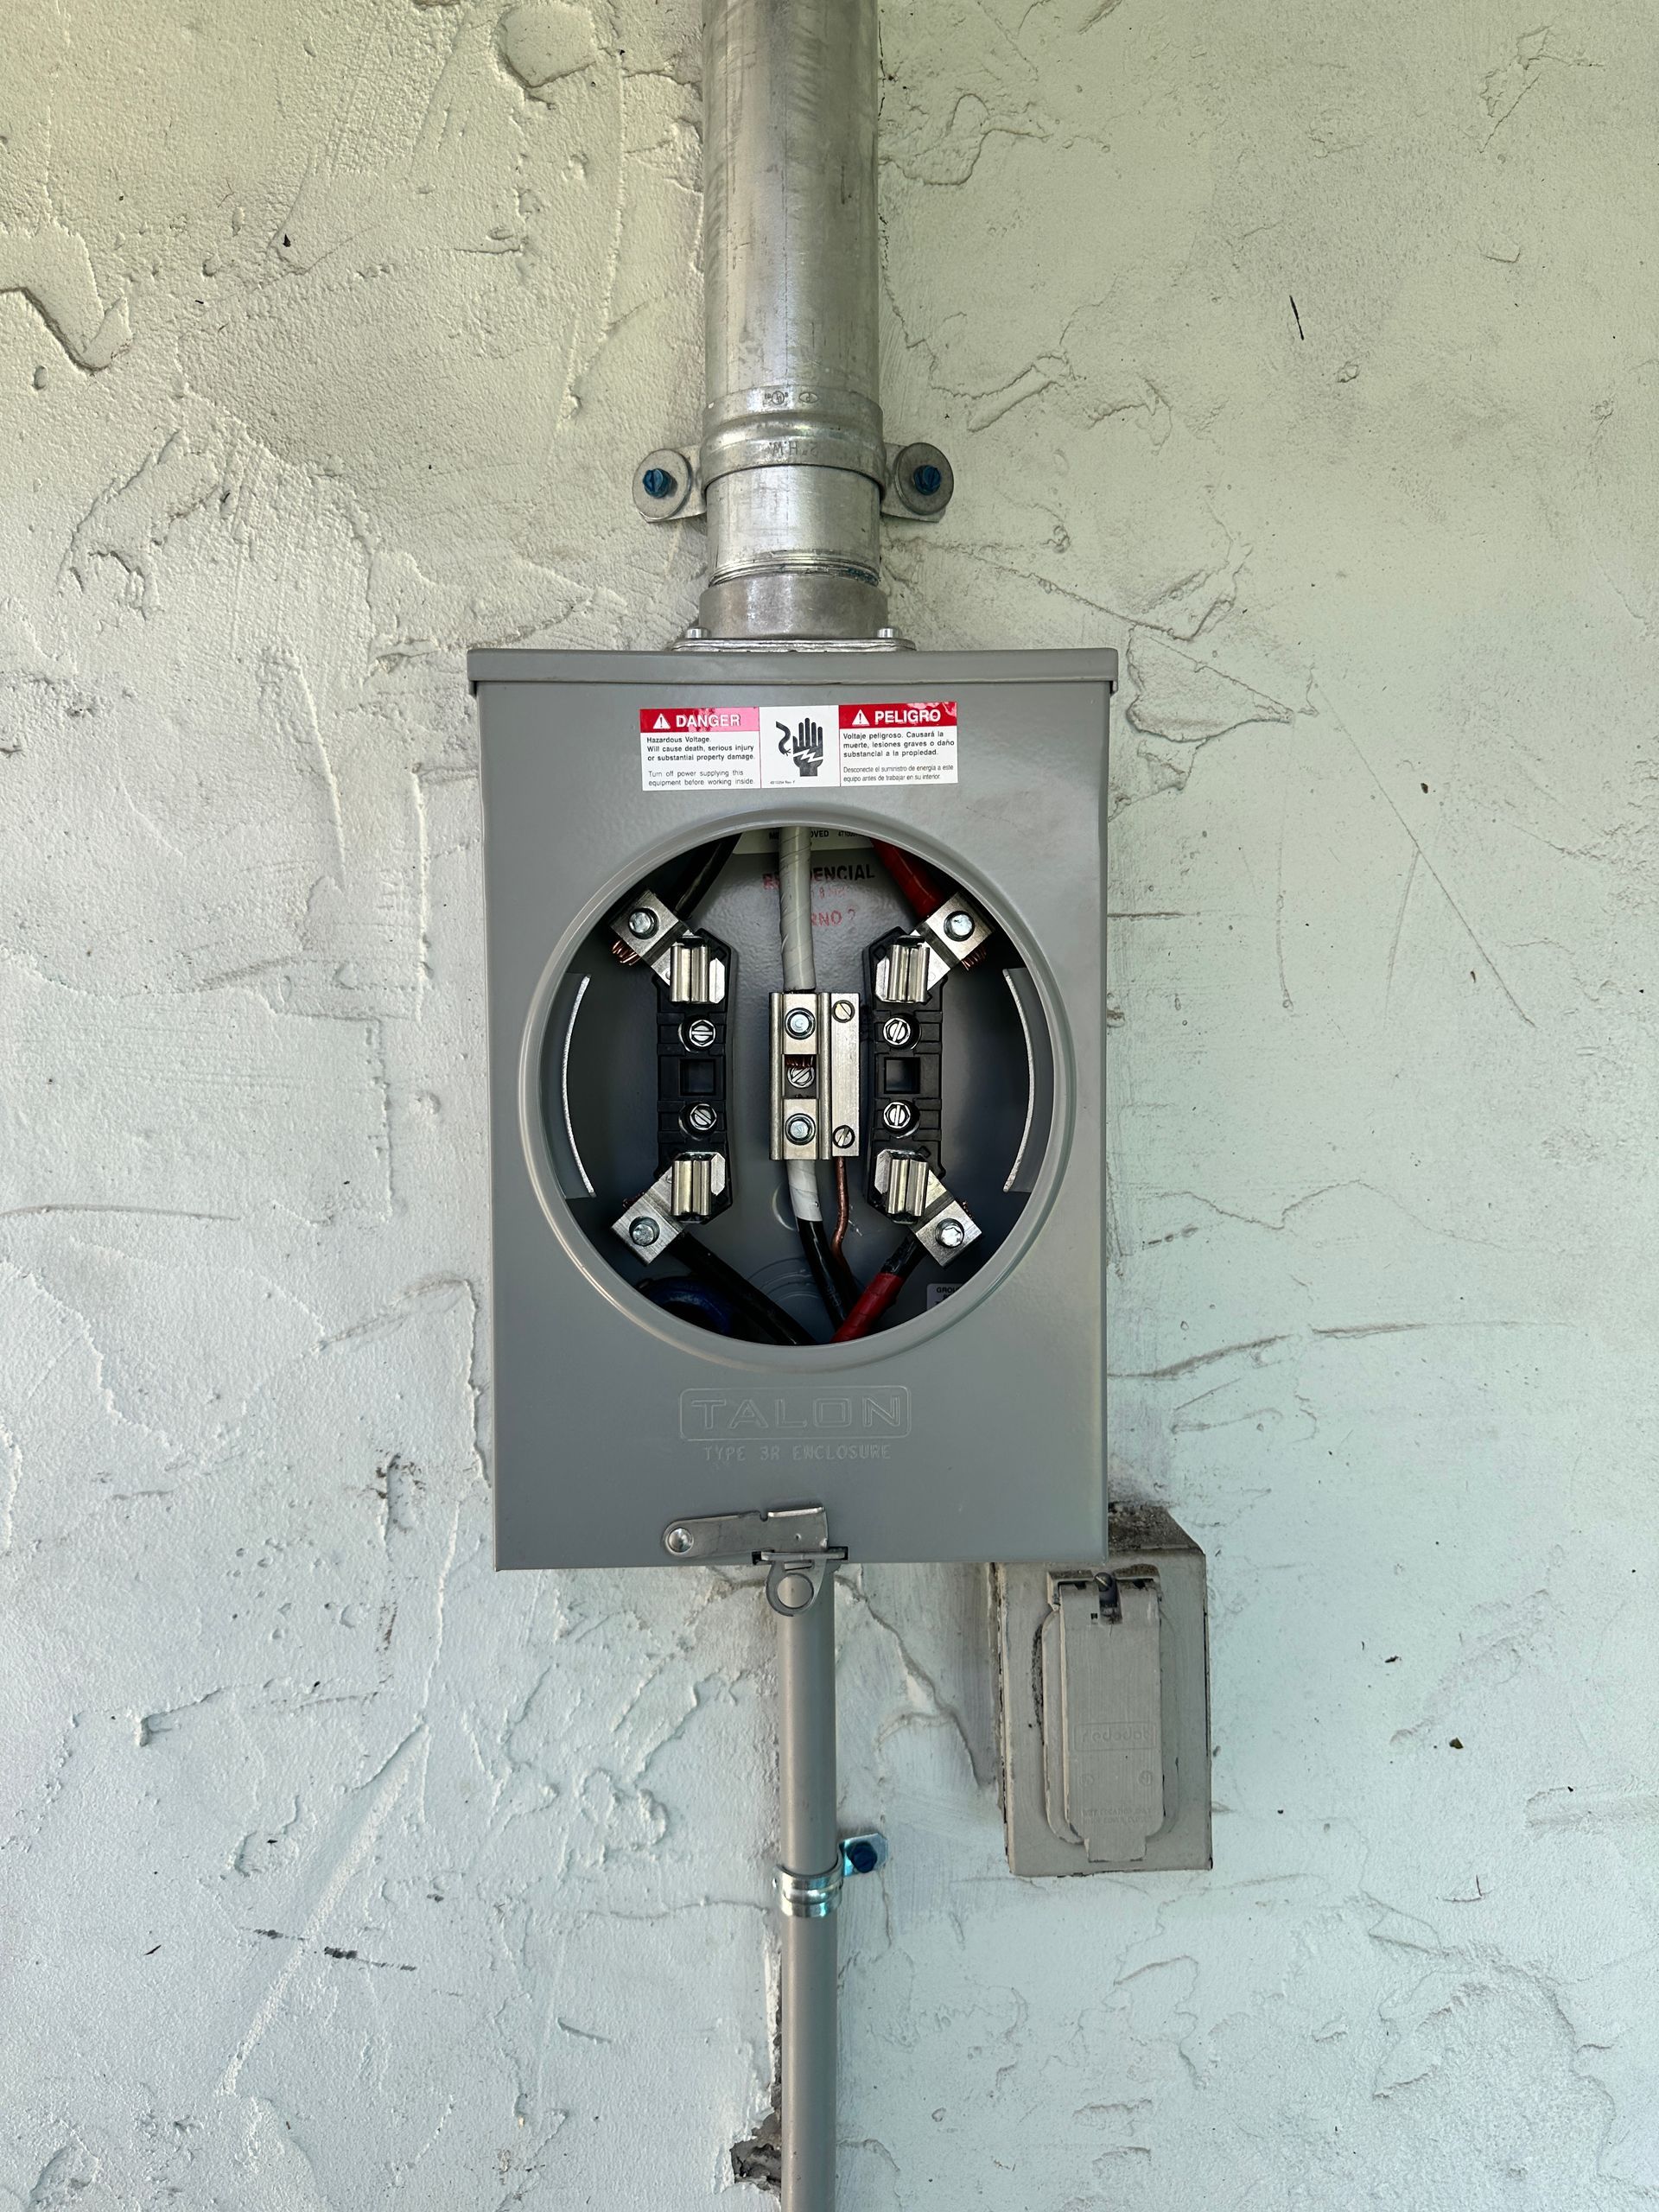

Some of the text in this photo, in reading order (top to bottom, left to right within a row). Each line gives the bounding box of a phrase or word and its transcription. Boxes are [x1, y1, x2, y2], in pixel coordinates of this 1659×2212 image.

[676, 714, 741, 728] DANGER
[874, 709, 941, 723] PELIGRO
[869, 732, 904, 741] peligroso.
[690, 1395, 902, 1430] TALON
[704, 1444, 892, 1461] TYPE 3R ENCLOSURE
